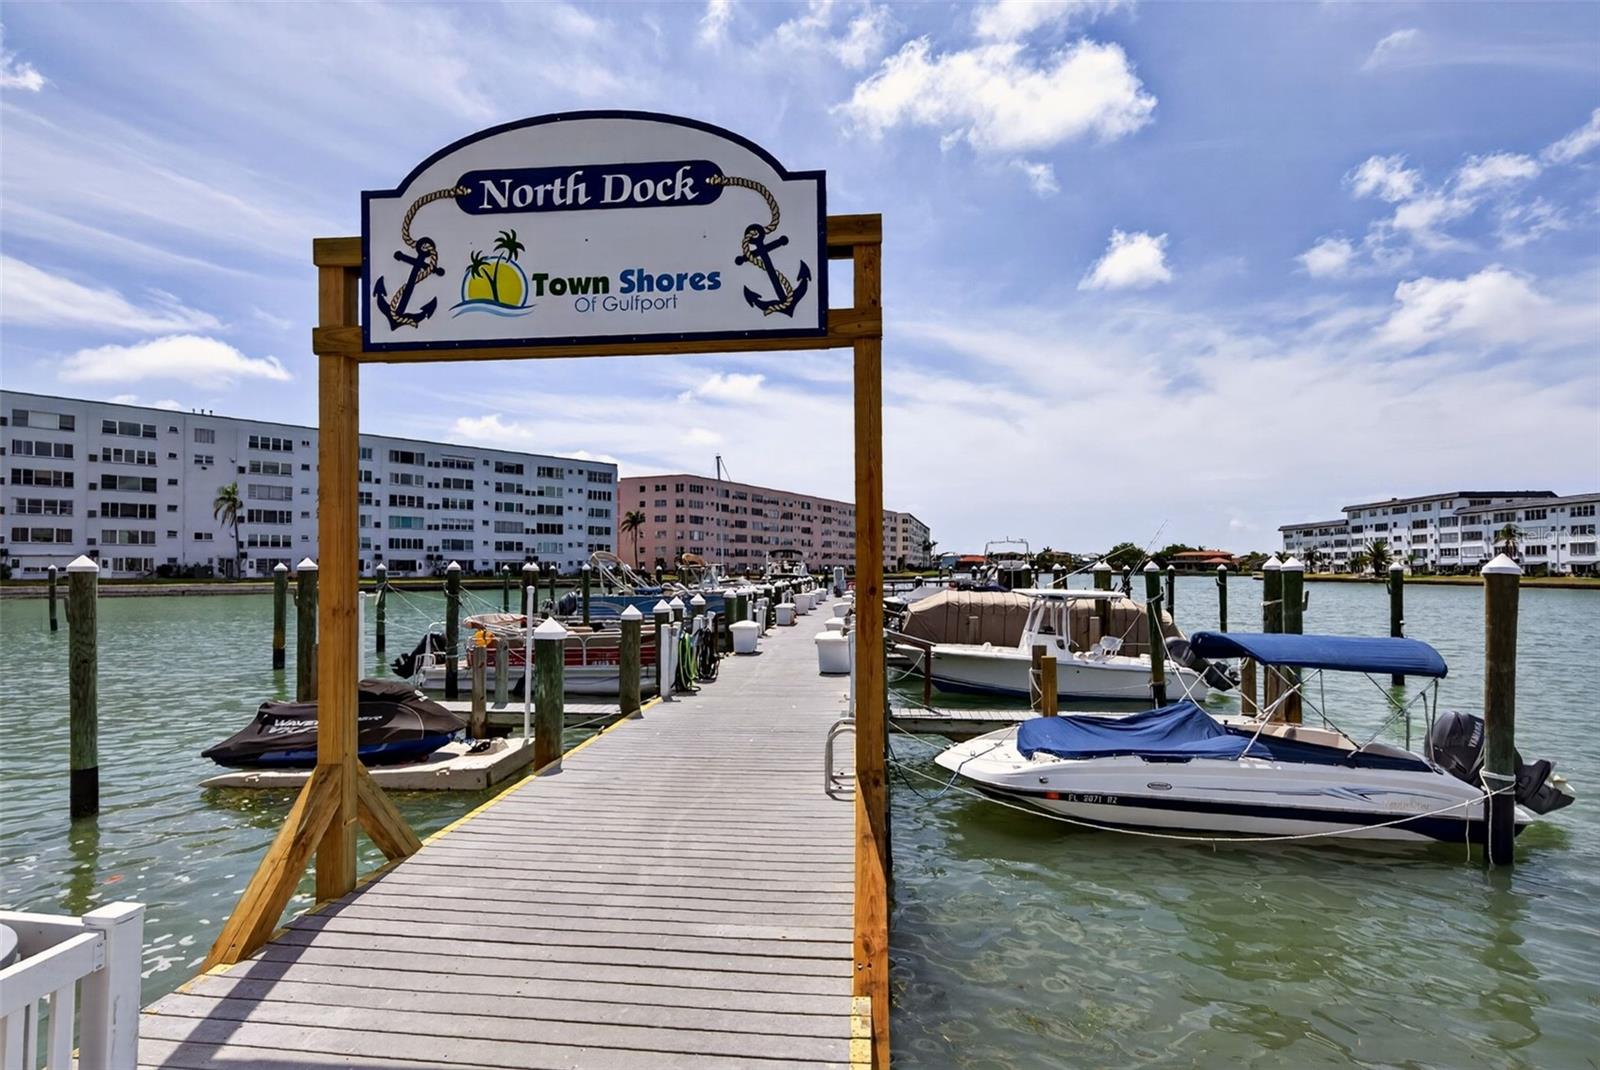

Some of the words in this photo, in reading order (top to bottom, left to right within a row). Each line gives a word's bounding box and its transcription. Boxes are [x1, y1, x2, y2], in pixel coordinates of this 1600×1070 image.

[479, 170, 591, 209] North
[600, 166, 699, 204] Dock
[532, 273, 610, 297] Town
[619, 268, 721, 294] Shores
[574, 296, 597, 313] Of
[602, 294, 678, 313] Gulfport
[1469, 721, 1483, 748] YAMAHA
